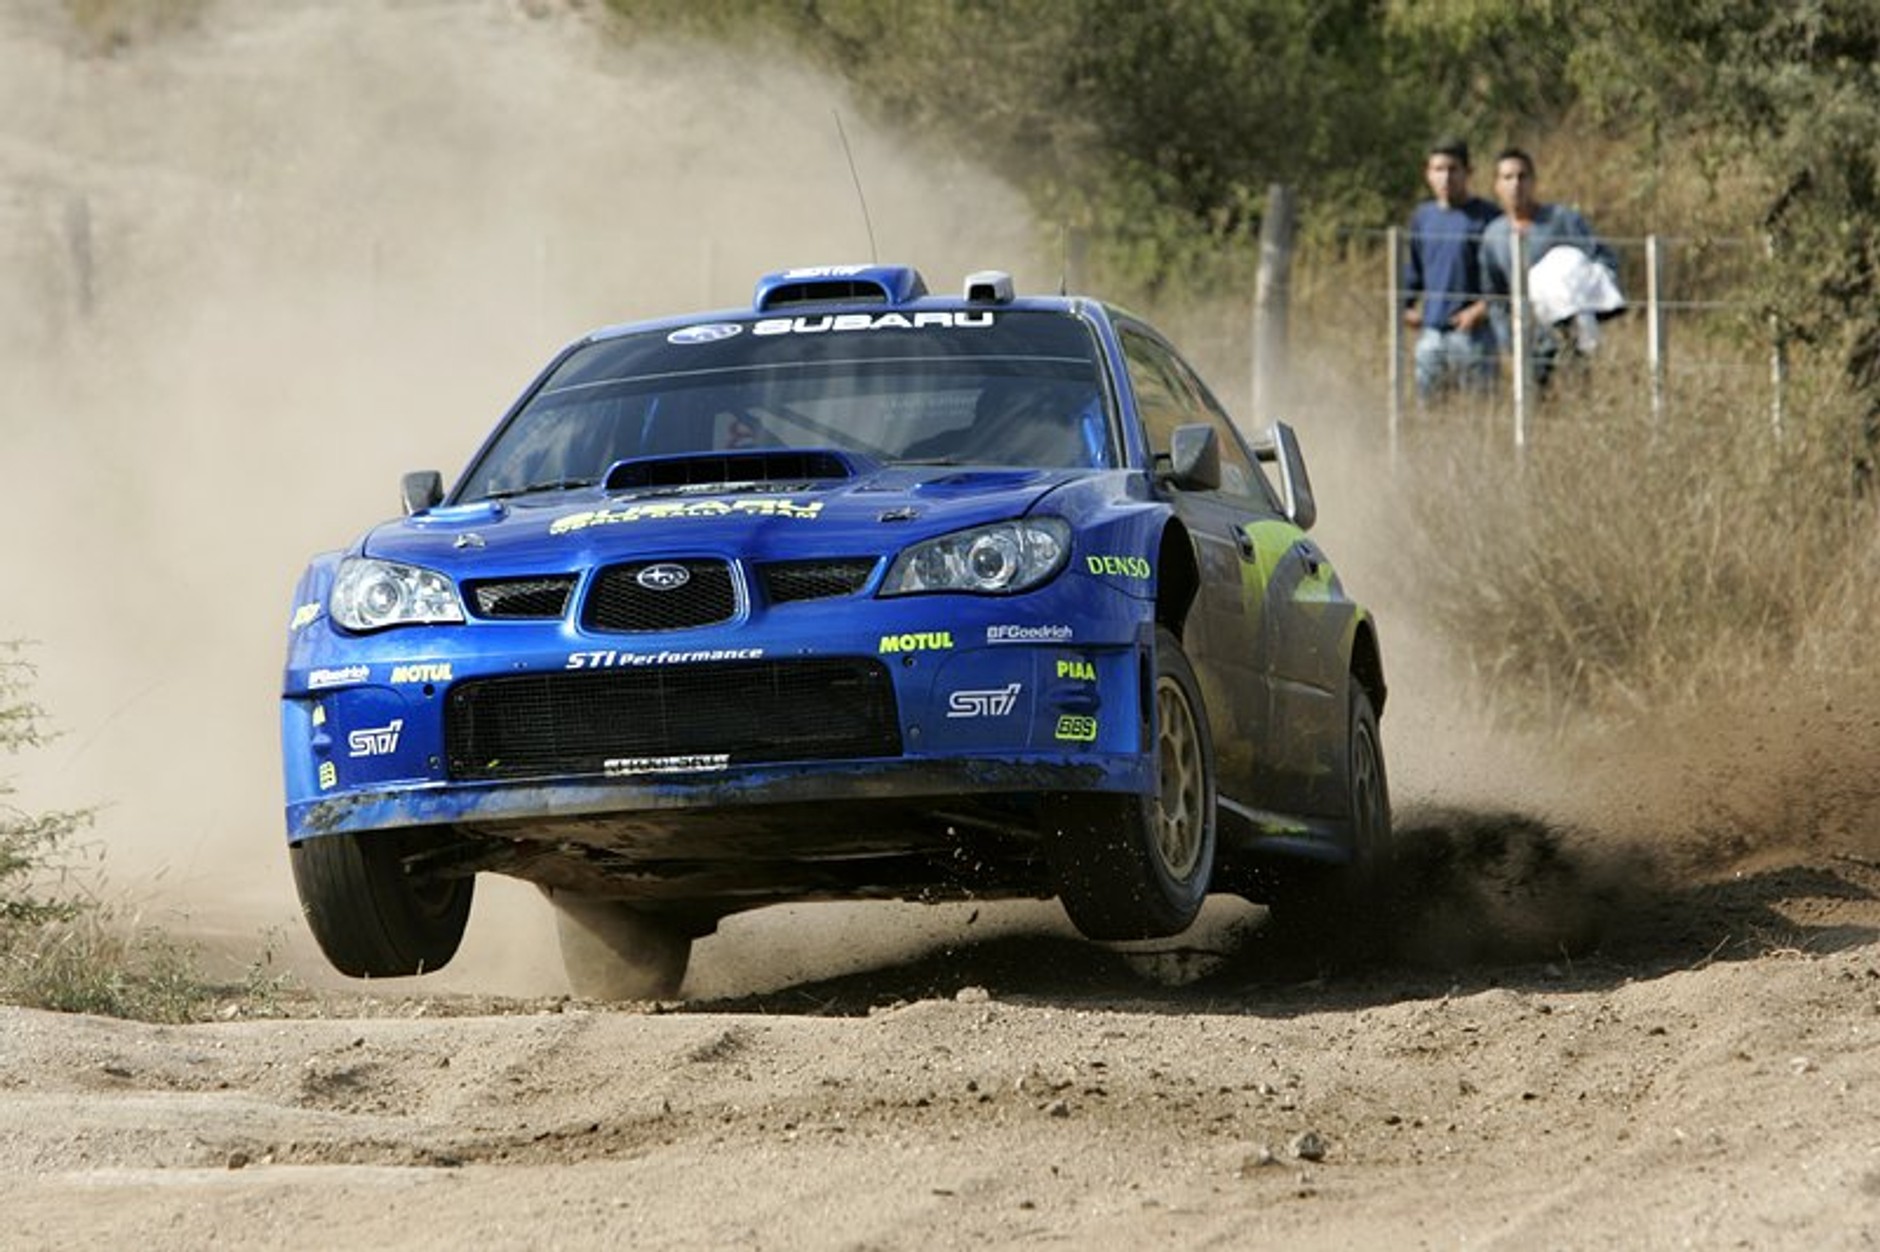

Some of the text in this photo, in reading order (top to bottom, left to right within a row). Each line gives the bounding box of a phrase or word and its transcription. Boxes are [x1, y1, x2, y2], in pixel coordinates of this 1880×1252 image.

[752, 311, 994, 336] SUBARU
[1087, 555, 1151, 579] DENSO
[879, 631, 954, 654] MOTUL
[987, 625, 1073, 644] BFGoodrich
[566, 648, 764, 669] STI Performance
[390, 663, 453, 684] MOTUL
[1056, 659, 1096, 681] PIAA
[1056, 714, 1097, 741] BBS
